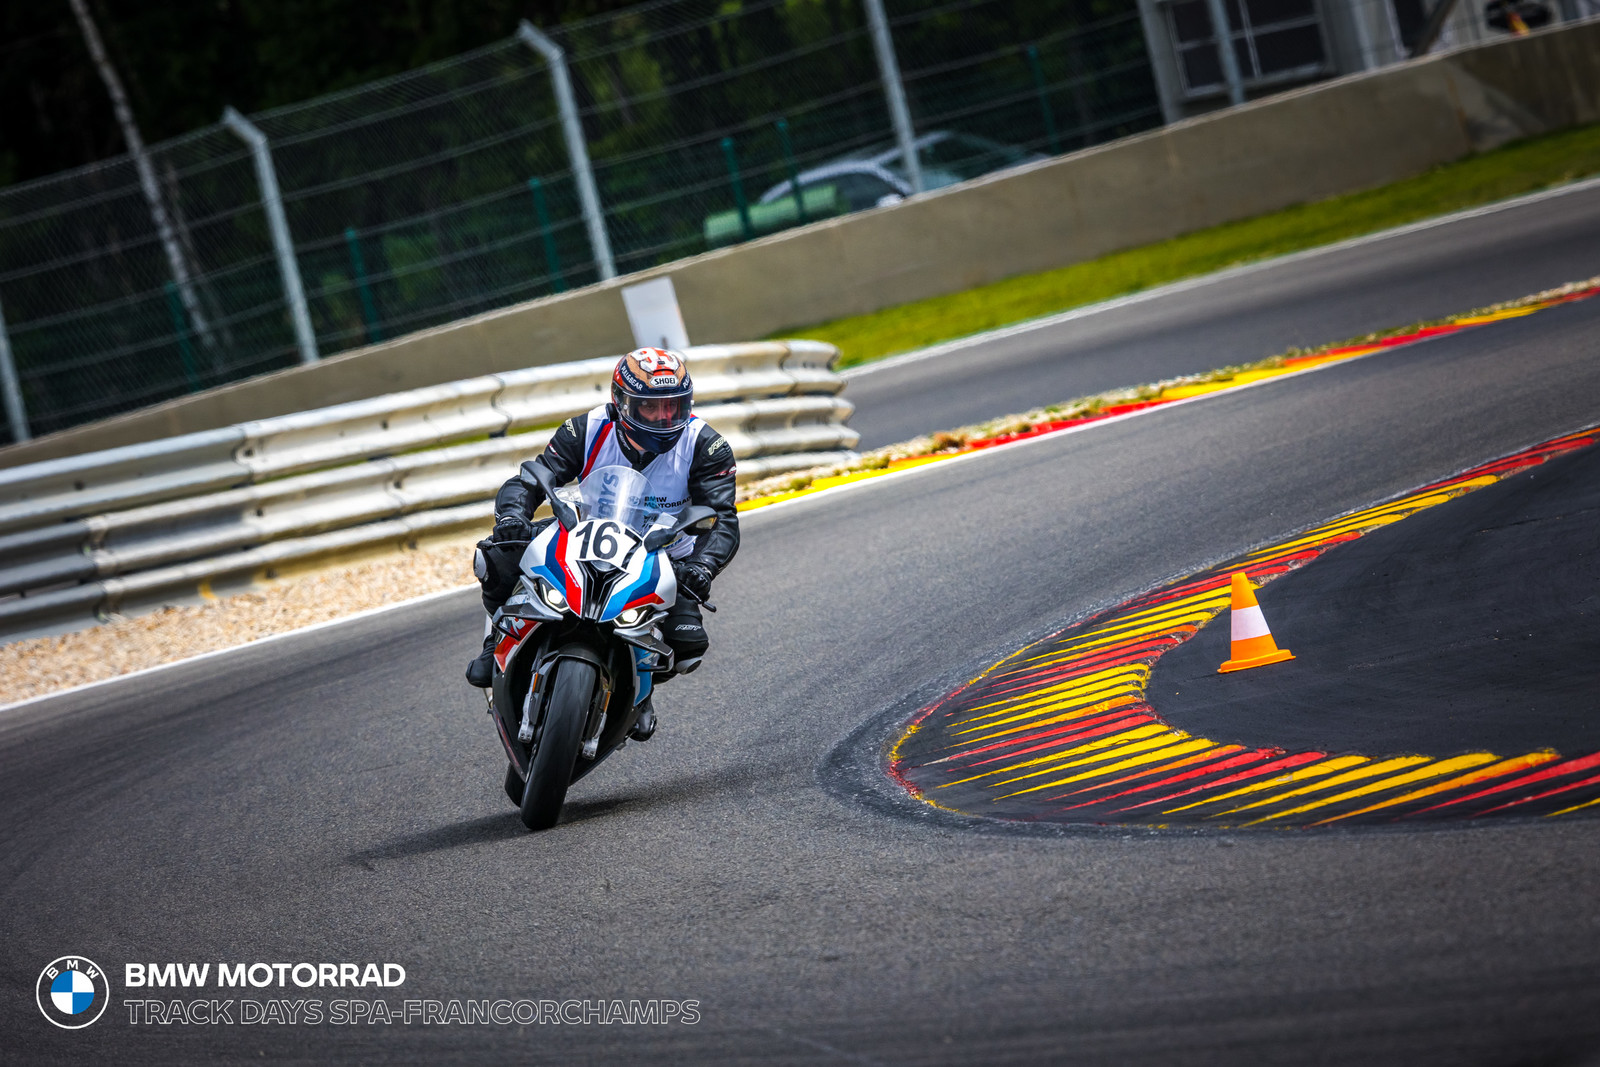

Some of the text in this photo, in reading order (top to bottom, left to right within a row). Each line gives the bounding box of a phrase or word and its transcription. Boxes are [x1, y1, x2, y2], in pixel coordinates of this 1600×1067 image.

[620, 365, 643, 391] PULL&BEAR
[654, 378, 676, 386] SHOEI
[575, 521, 644, 570] 167
